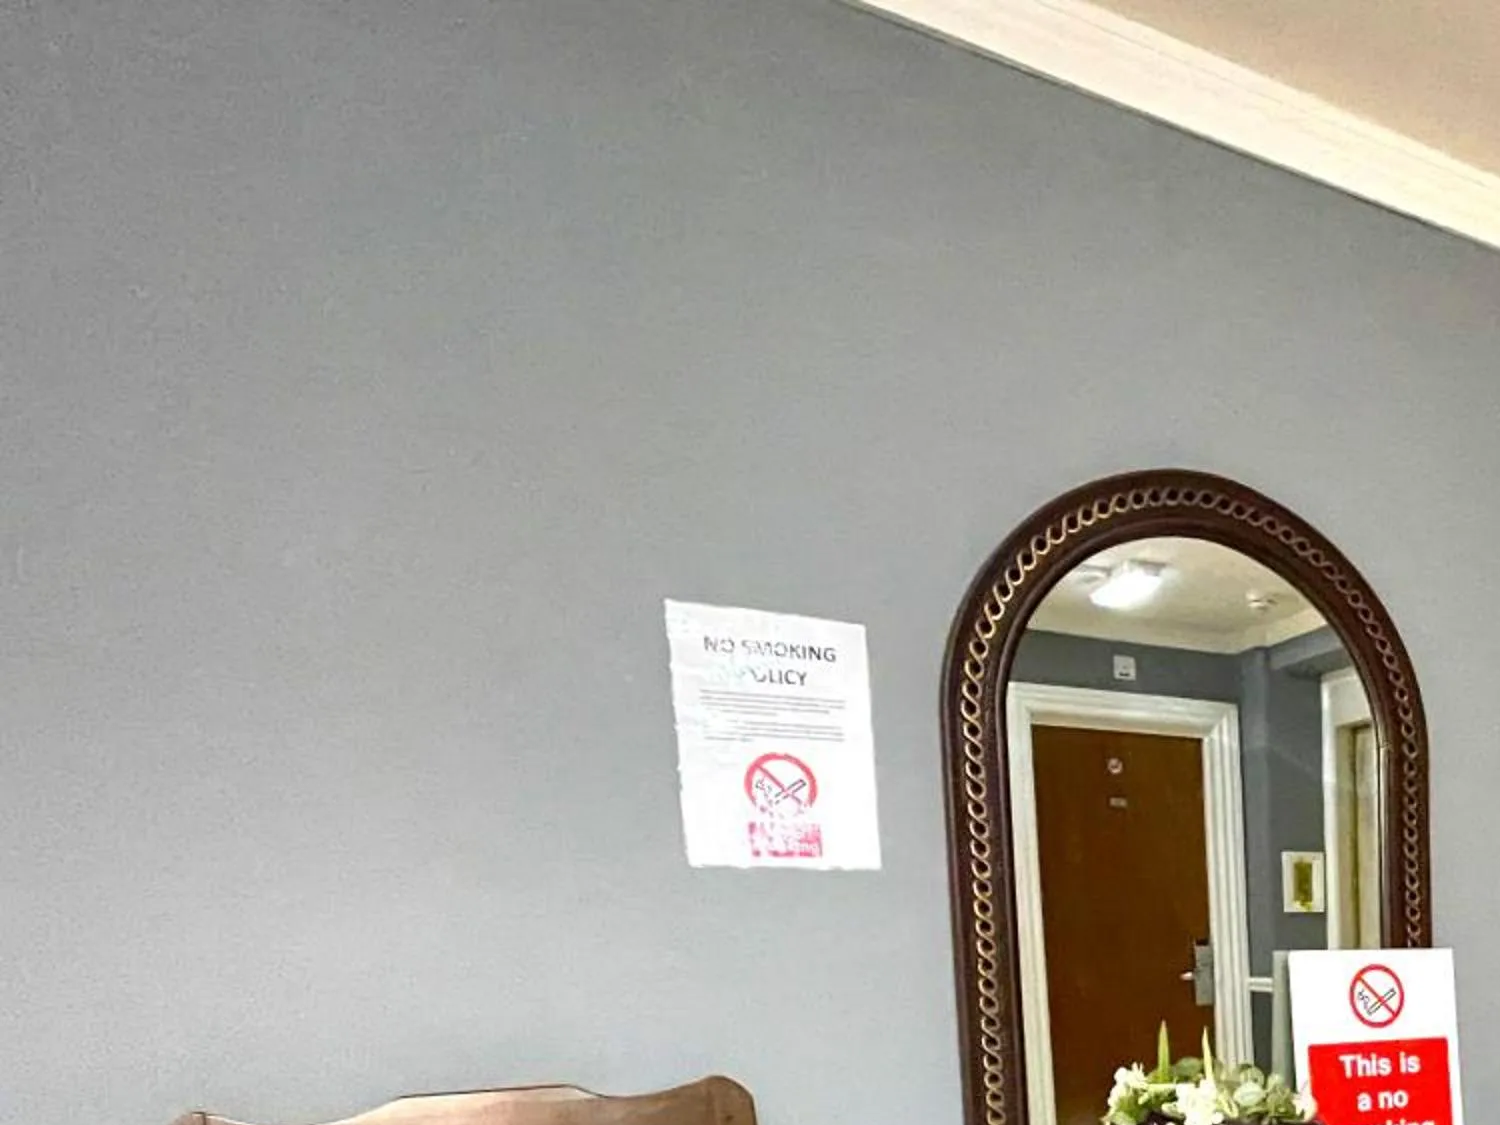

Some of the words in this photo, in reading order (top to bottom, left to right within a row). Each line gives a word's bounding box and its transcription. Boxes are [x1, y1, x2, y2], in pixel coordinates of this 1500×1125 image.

[703, 635, 735, 653] NO
[741, 639, 837, 662] SMOKING
[738, 665, 807, 686] OLICY
[1339, 1054, 1392, 1079] This
[1399, 1051, 1421, 1074] is
[1357, 1092, 1371, 1112] a
[1378, 1089, 1408, 1109] no
